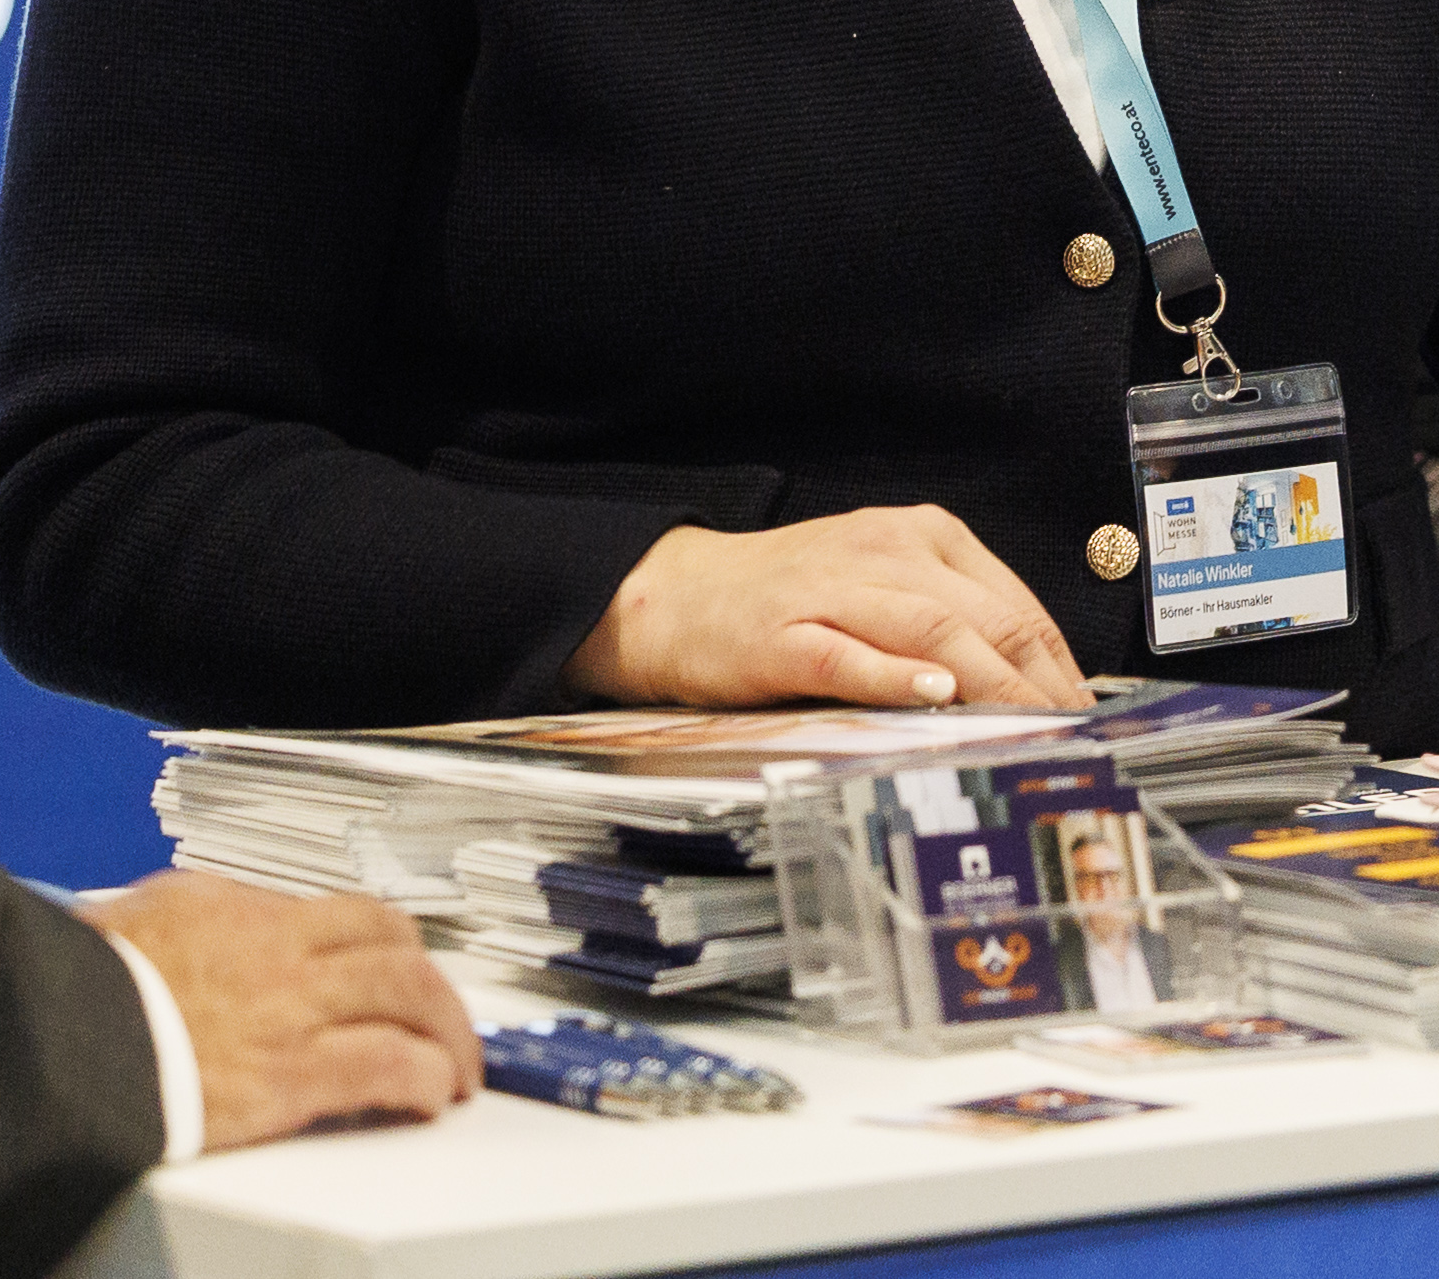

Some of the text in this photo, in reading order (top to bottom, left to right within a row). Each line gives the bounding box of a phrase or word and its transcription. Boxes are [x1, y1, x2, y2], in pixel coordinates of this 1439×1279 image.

[1121, 101, 1176, 221] www.enteco.at
[1167, 516, 1196, 527] WOHN
[1168, 528, 1196, 539] MESSE
[1157, 562, 1253, 590] Natalie Winkler
[1160, 605, 1193, 620] Börner
[1203, 600, 1216, 614] Ihr
[1217, 593, 1273, 612] Hausmakler
